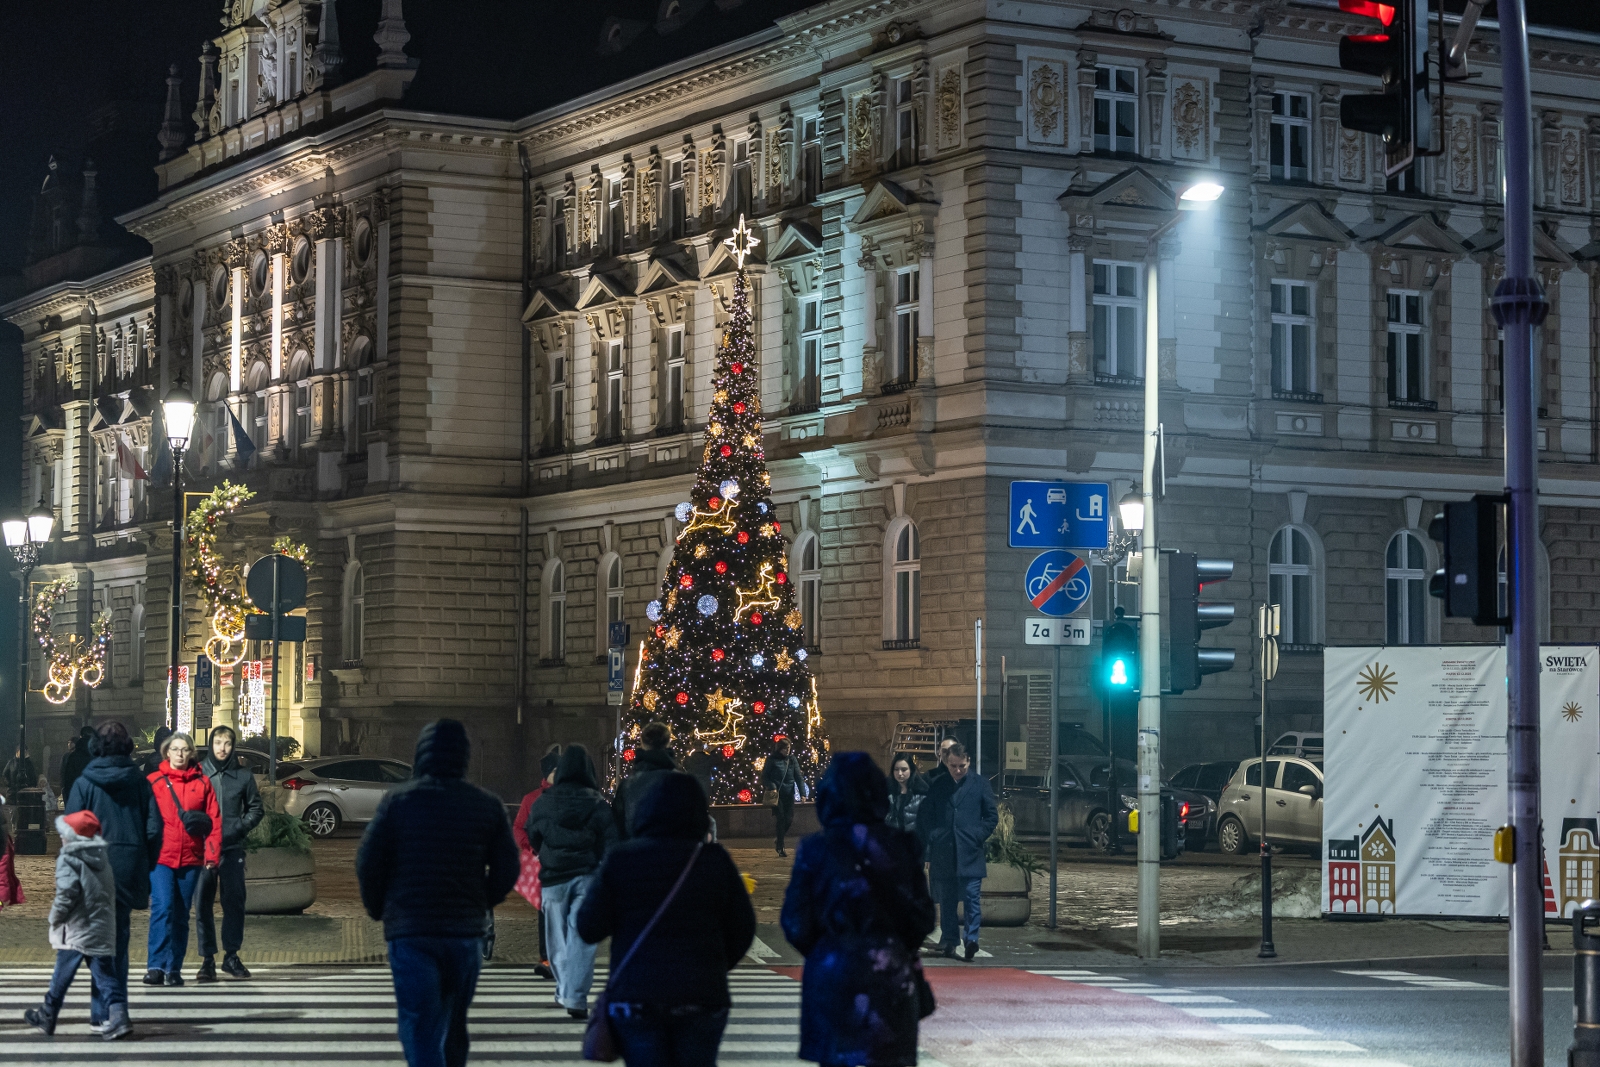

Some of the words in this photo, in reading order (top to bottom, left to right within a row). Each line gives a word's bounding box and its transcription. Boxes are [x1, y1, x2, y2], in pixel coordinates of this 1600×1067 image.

[1032, 623, 1050, 638] Za
[1063, 624, 1085, 639] 5m
[612, 652, 621, 679] P
